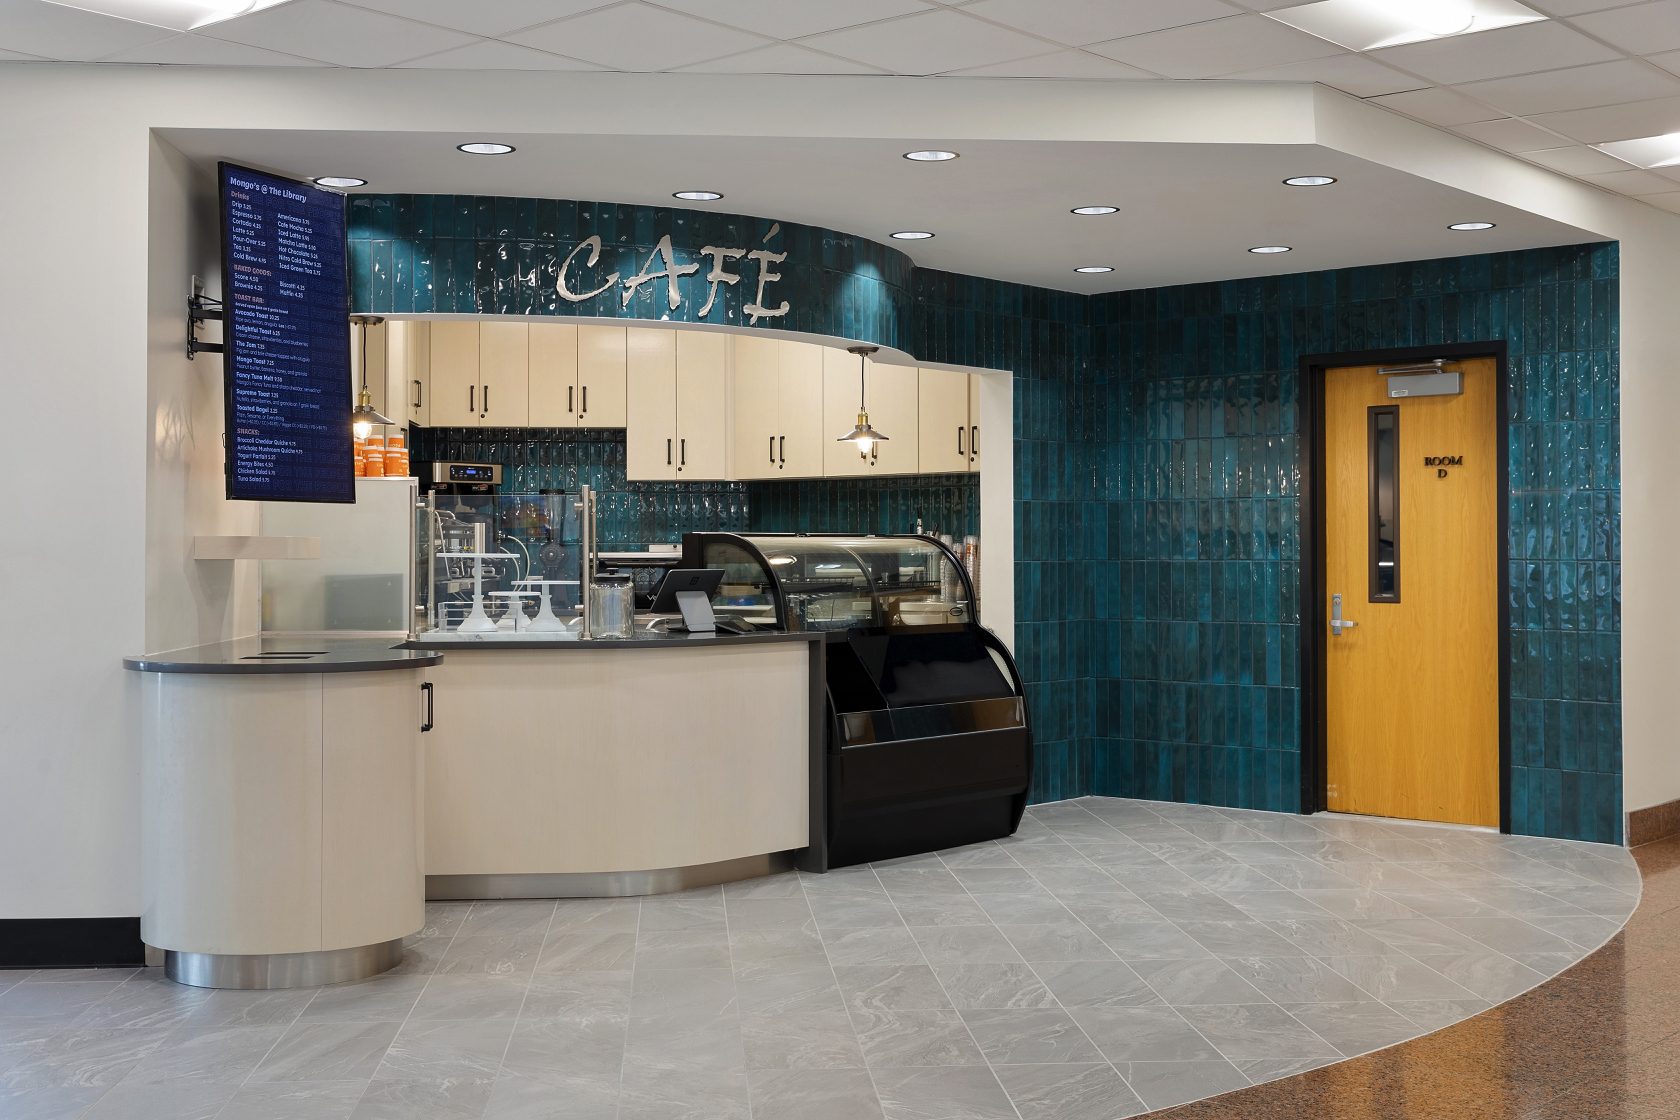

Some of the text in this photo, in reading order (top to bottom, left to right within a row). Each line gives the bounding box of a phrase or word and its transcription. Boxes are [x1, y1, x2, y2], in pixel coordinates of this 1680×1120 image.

[231, 177, 307, 204] Mongo's @ The Library
[231, 191, 249, 200] Drinks
[232, 200, 243, 210] Drip
[233, 209, 253, 220] Espresso
[278, 212, 301, 223] Americano
[233, 218, 251, 227] Cortado
[233, 226, 245, 234] Latte
[290, 224, 304, 232] Mocha
[278, 229, 289, 237] Iced
[233, 235, 257, 245] Pour-Over
[278, 238, 295, 246] Matcha
[288, 248, 310, 258] Chocolate
[234, 265, 251, 273] BAKED
[291, 265, 304, 273] Green
[556, 222, 790, 326] CAFÉ
[235, 281, 253, 289] Brownie
[280, 281, 295, 289] Biscotti
[280, 289, 294, 297] Muffin
[235, 309, 255, 317] Avocado
[236, 325, 258, 333] Delightful
[237, 356, 252, 364] Mongo
[1423, 455, 1464, 467] ROOM
[1437, 468, 1448, 479] D
